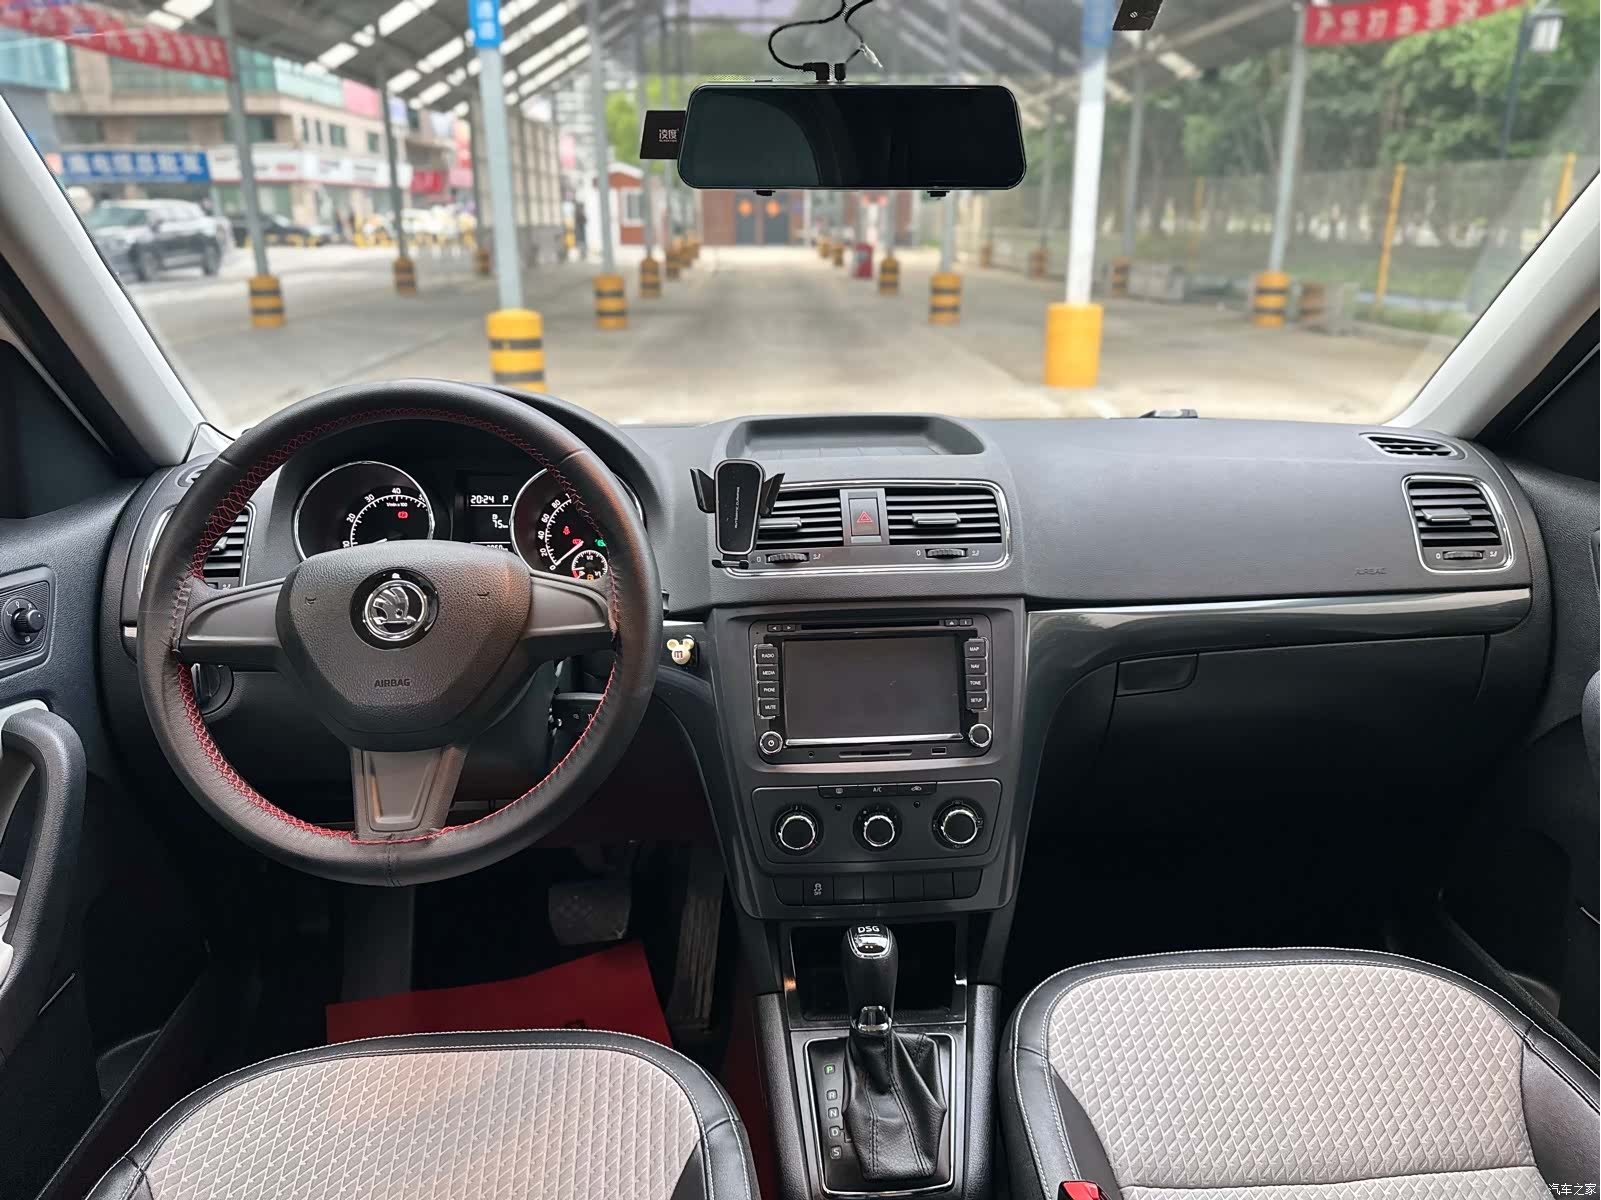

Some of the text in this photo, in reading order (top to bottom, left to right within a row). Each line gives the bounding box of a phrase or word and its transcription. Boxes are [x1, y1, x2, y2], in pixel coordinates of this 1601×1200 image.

[364, 494, 375, 503] 30
[470, 495, 509, 504] 20:24 P
[551, 499, 561, 509] 80
[346, 513, 356, 523] 20
[541, 513, 550, 523] 60
[537, 530, 545, 540] 40
[539, 547, 548, 557] 20
[374, 678, 410, 687] AIRBAG
[857, 925, 880, 934] DSG
[826, 1065, 833, 1074] P
[829, 1091, 836, 1099] R
[830, 1109, 837, 1117] N
[831, 1128, 839, 1137] D
[833, 1147, 840, 1157] S
